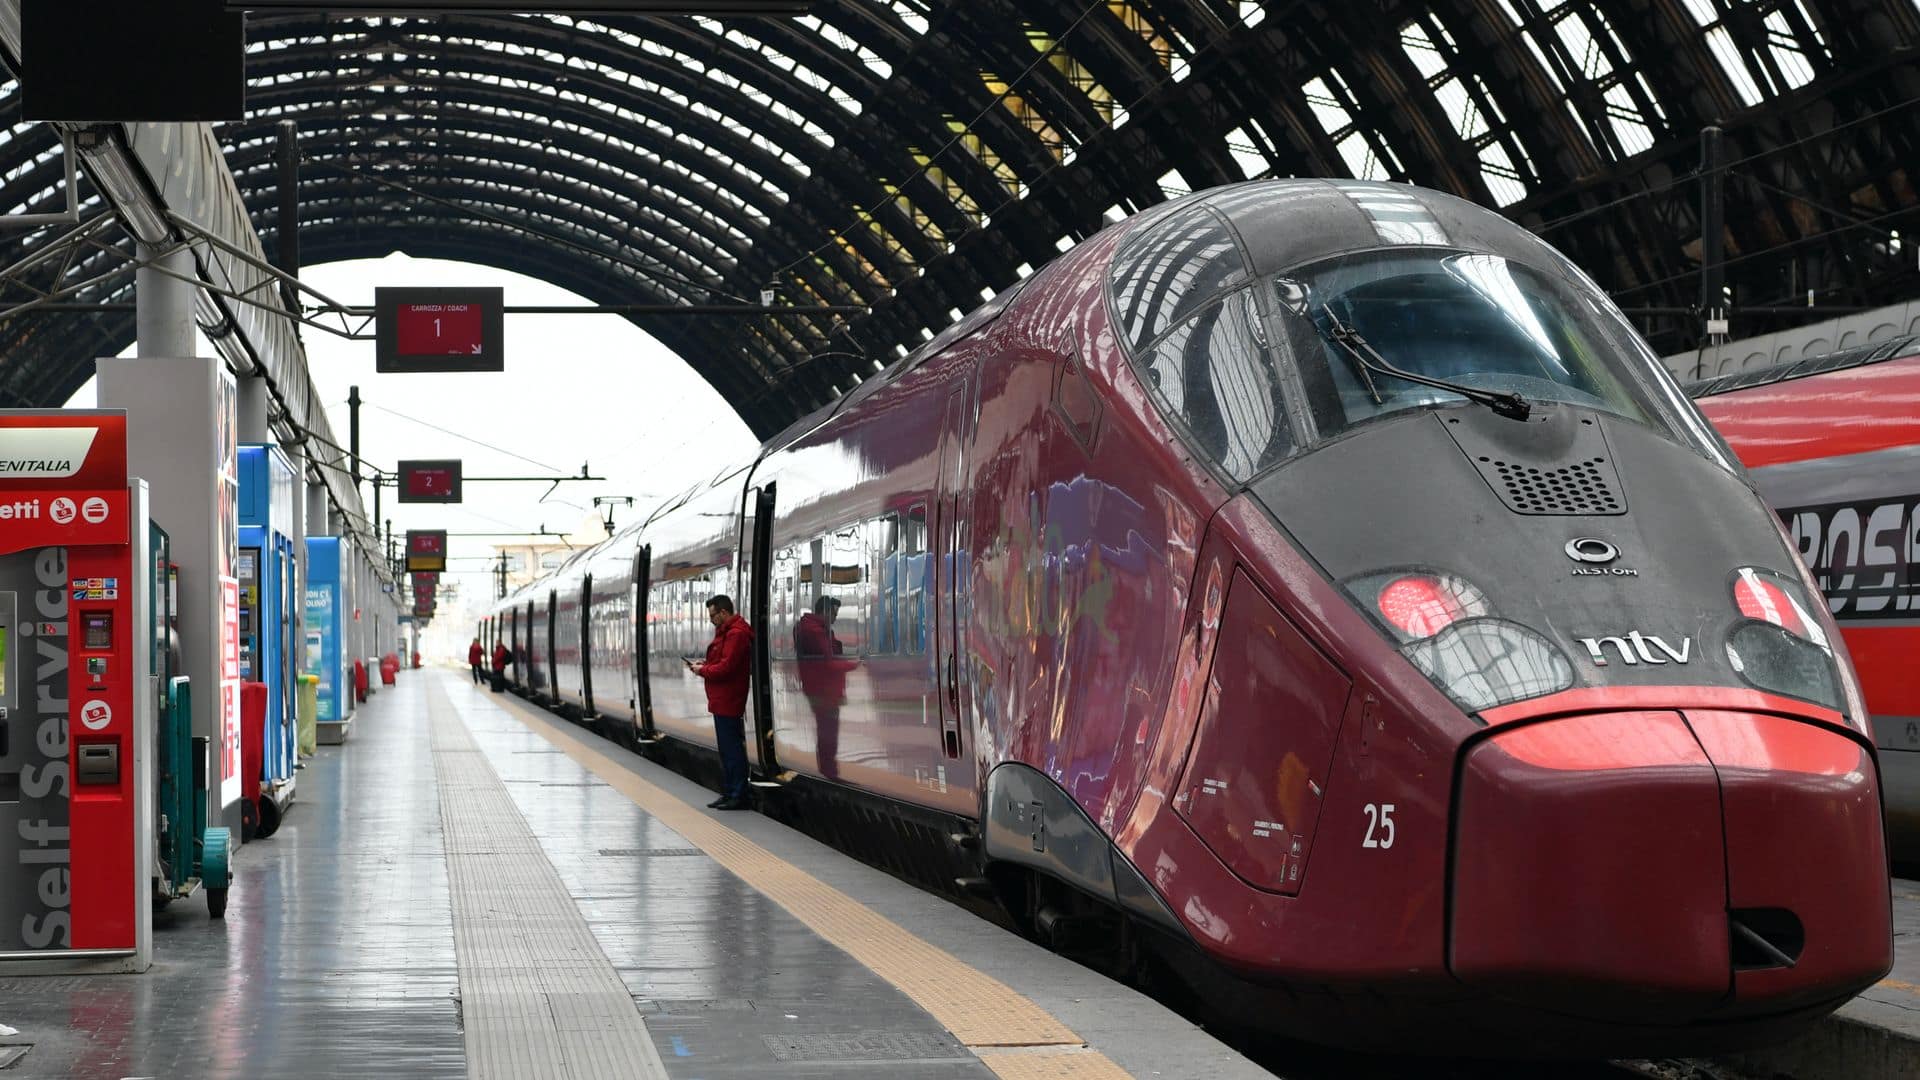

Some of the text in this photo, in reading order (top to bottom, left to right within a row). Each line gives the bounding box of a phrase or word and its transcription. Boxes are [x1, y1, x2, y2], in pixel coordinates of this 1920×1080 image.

[411, 304, 442, 312] CARROZZA
[447, 304, 468, 312] COACH
[433, 318, 441, 337] 1
[426, 475, 432, 487] 2
[0, 498, 40, 520] etti
[1571, 566, 1639, 577] ALSTOM
[1576, 630, 1691, 667] ntv
[18, 547, 71, 948] Self Service
[1362, 803, 1396, 850] 25
